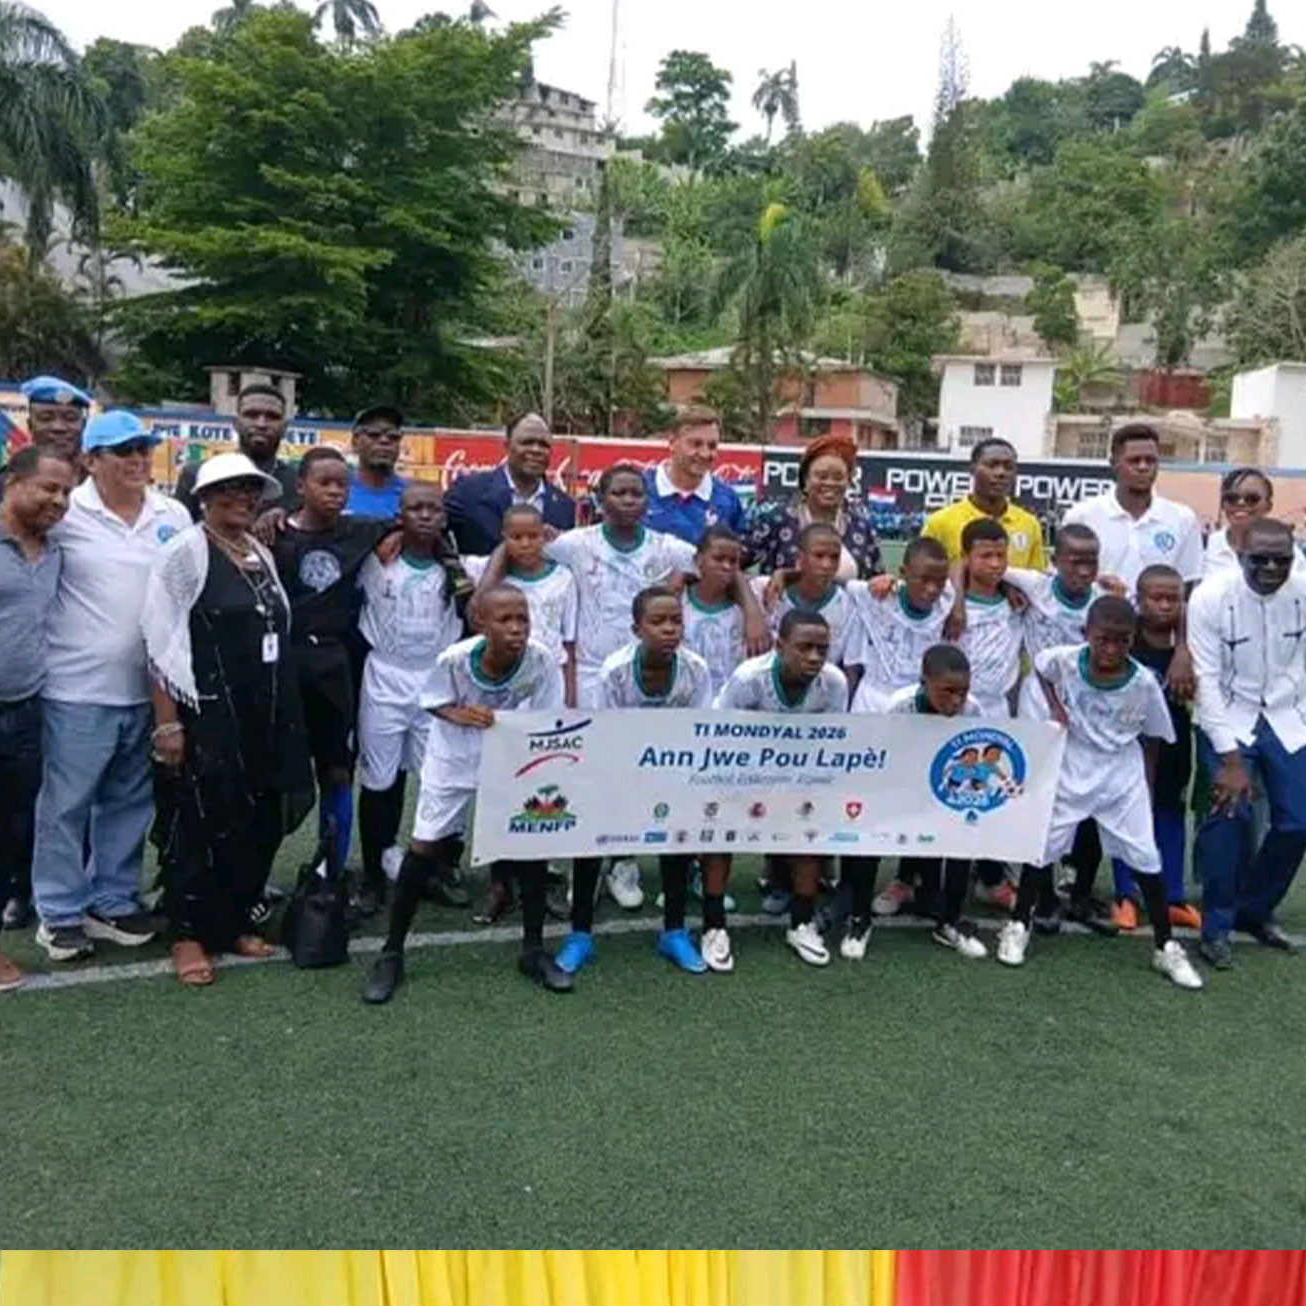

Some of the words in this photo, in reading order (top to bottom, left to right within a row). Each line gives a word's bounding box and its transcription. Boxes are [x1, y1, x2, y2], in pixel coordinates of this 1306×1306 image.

[189, 425, 232, 440] KOTE
[886, 467, 975, 496] POWE
[694, 723, 709, 738] TI
[713, 724, 804, 741] MONDYAL
[808, 726, 847, 741] 2026
[529, 736, 584, 752] MJSAC
[638, 746, 694, 767] Ann
[699, 747, 751, 771] Jwe
[759, 747, 808, 768] Pou
[816, 747, 888, 773] Lapè!
[508, 820, 577, 835] MENFP
